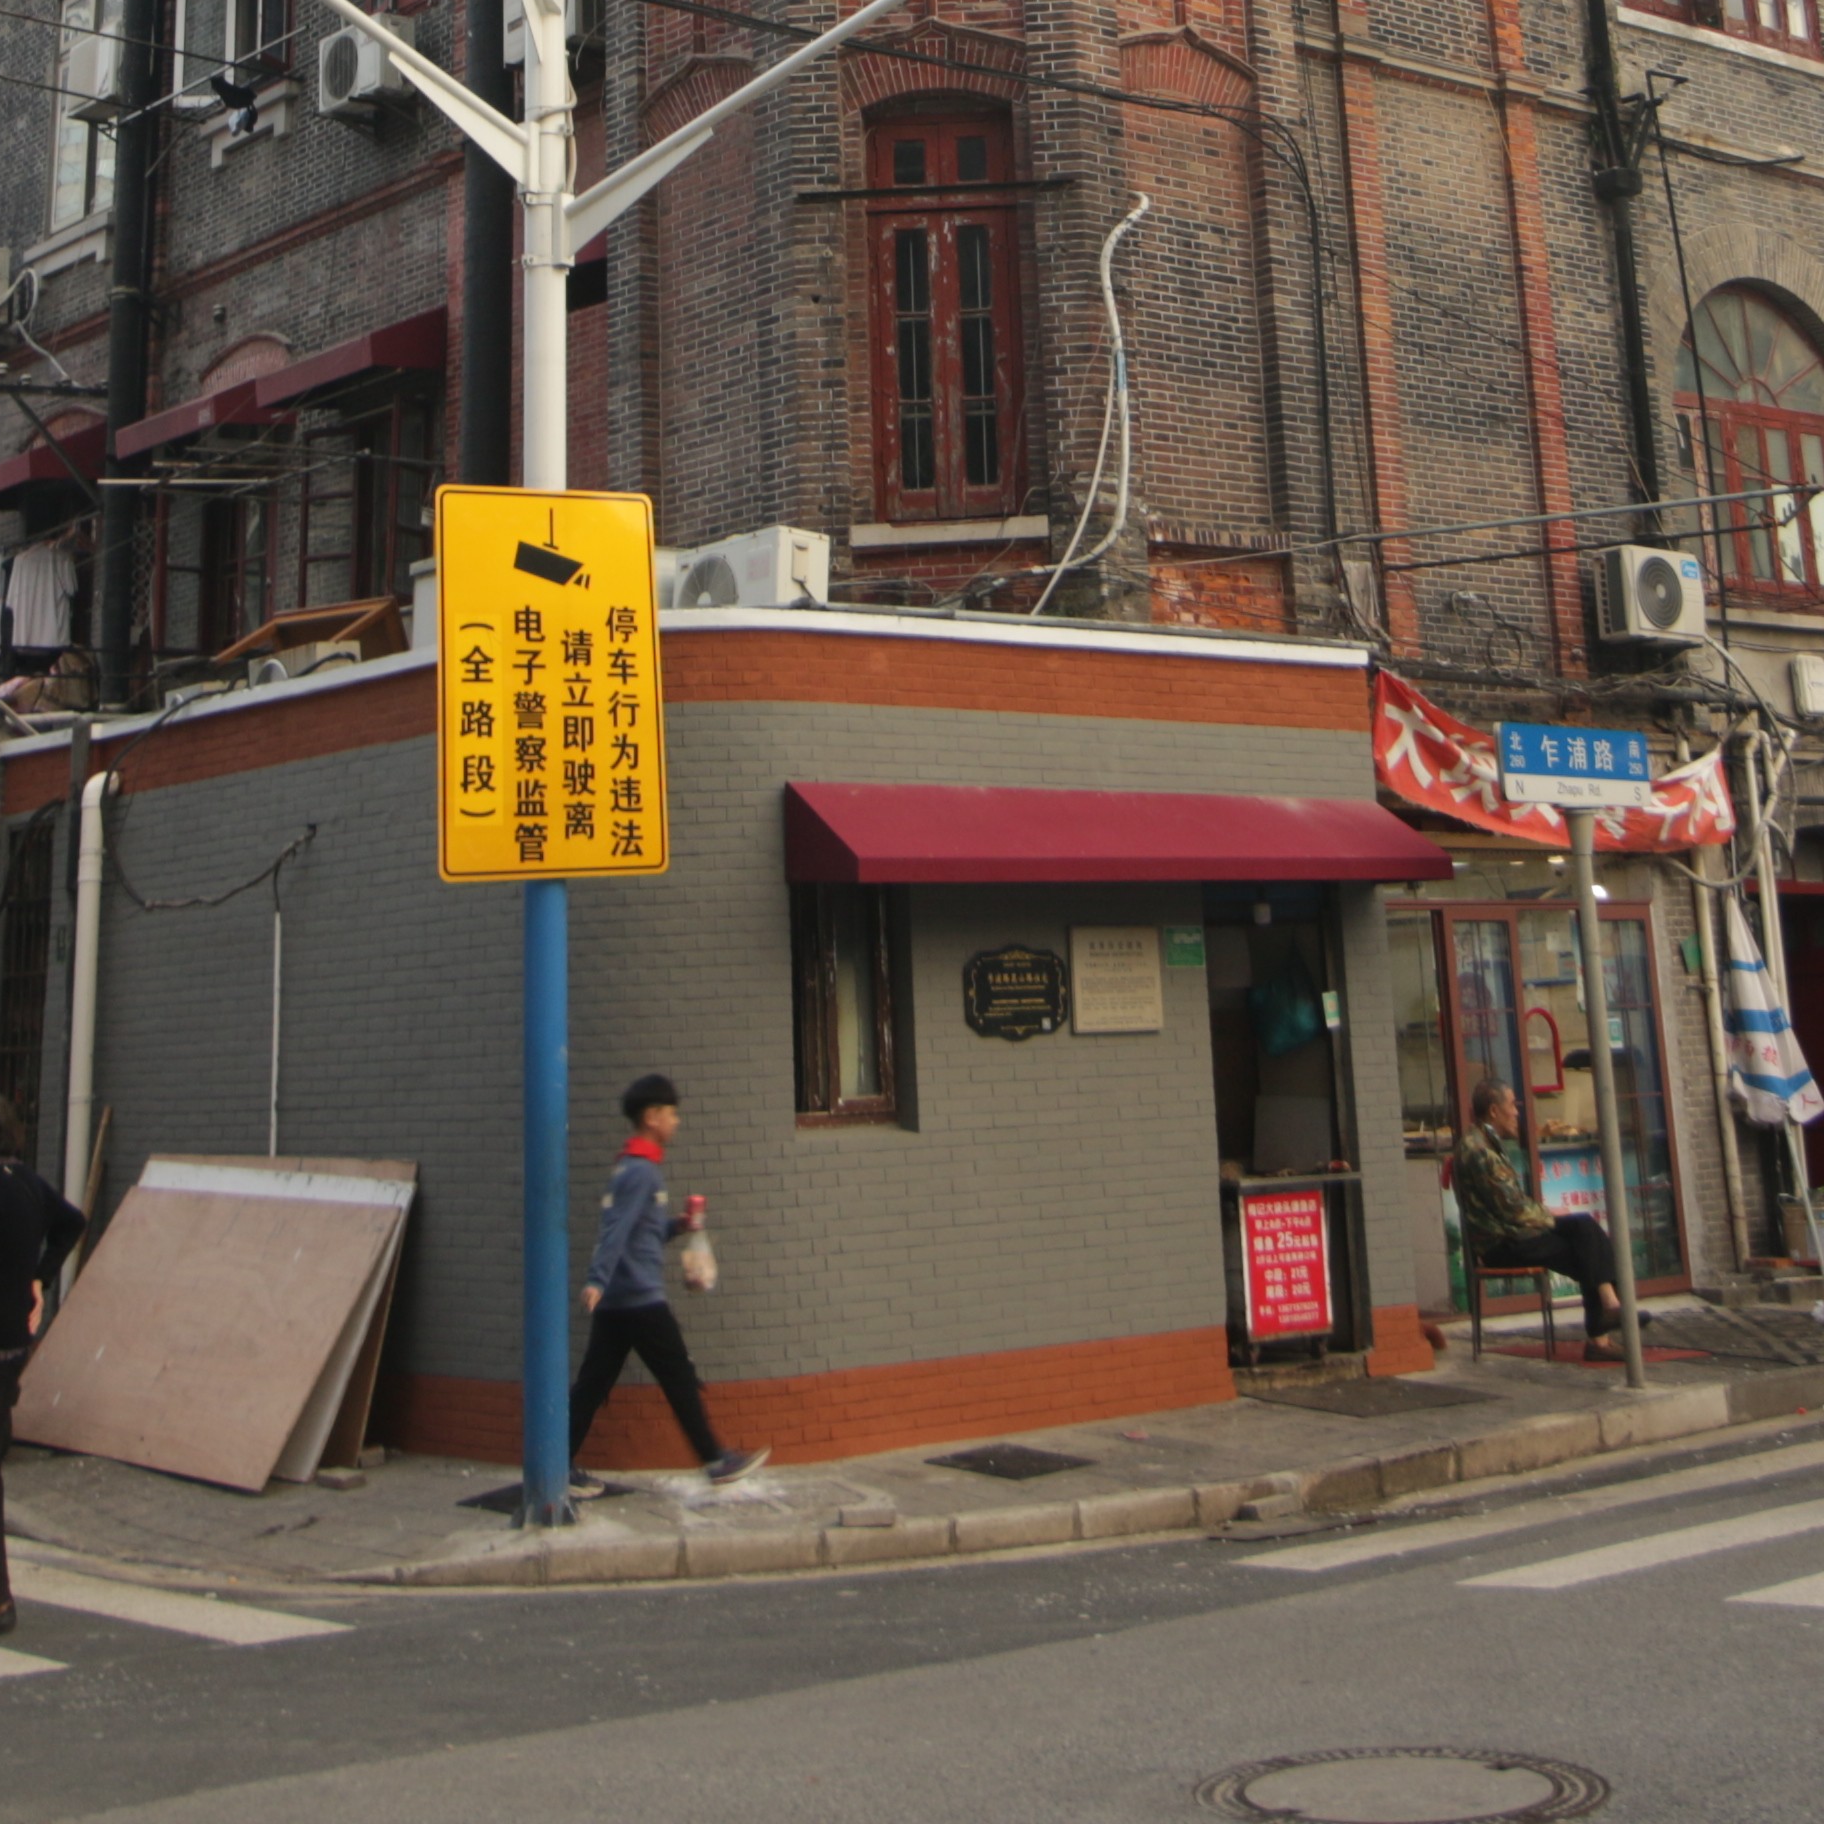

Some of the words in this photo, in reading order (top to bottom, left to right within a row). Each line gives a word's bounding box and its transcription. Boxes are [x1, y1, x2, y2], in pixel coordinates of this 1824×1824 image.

[459, 623, 496, 817] （全路段）
[605, 606, 645, 858] 停车行为违法
[512, 606, 549, 863] 电子警察监管
[560, 629, 596, 840] 请立即驶离
[1509, 731, 1523, 751] 北
[1540, 735, 1614, 771] 乍浦路
[1628, 740, 1641, 759] 南
[1515, 779, 1525, 795] N
[1557, 781, 1583, 798] Zhapu
[1588, 783, 1602, 797] Rd.
[1634, 786, 1642, 801] S
